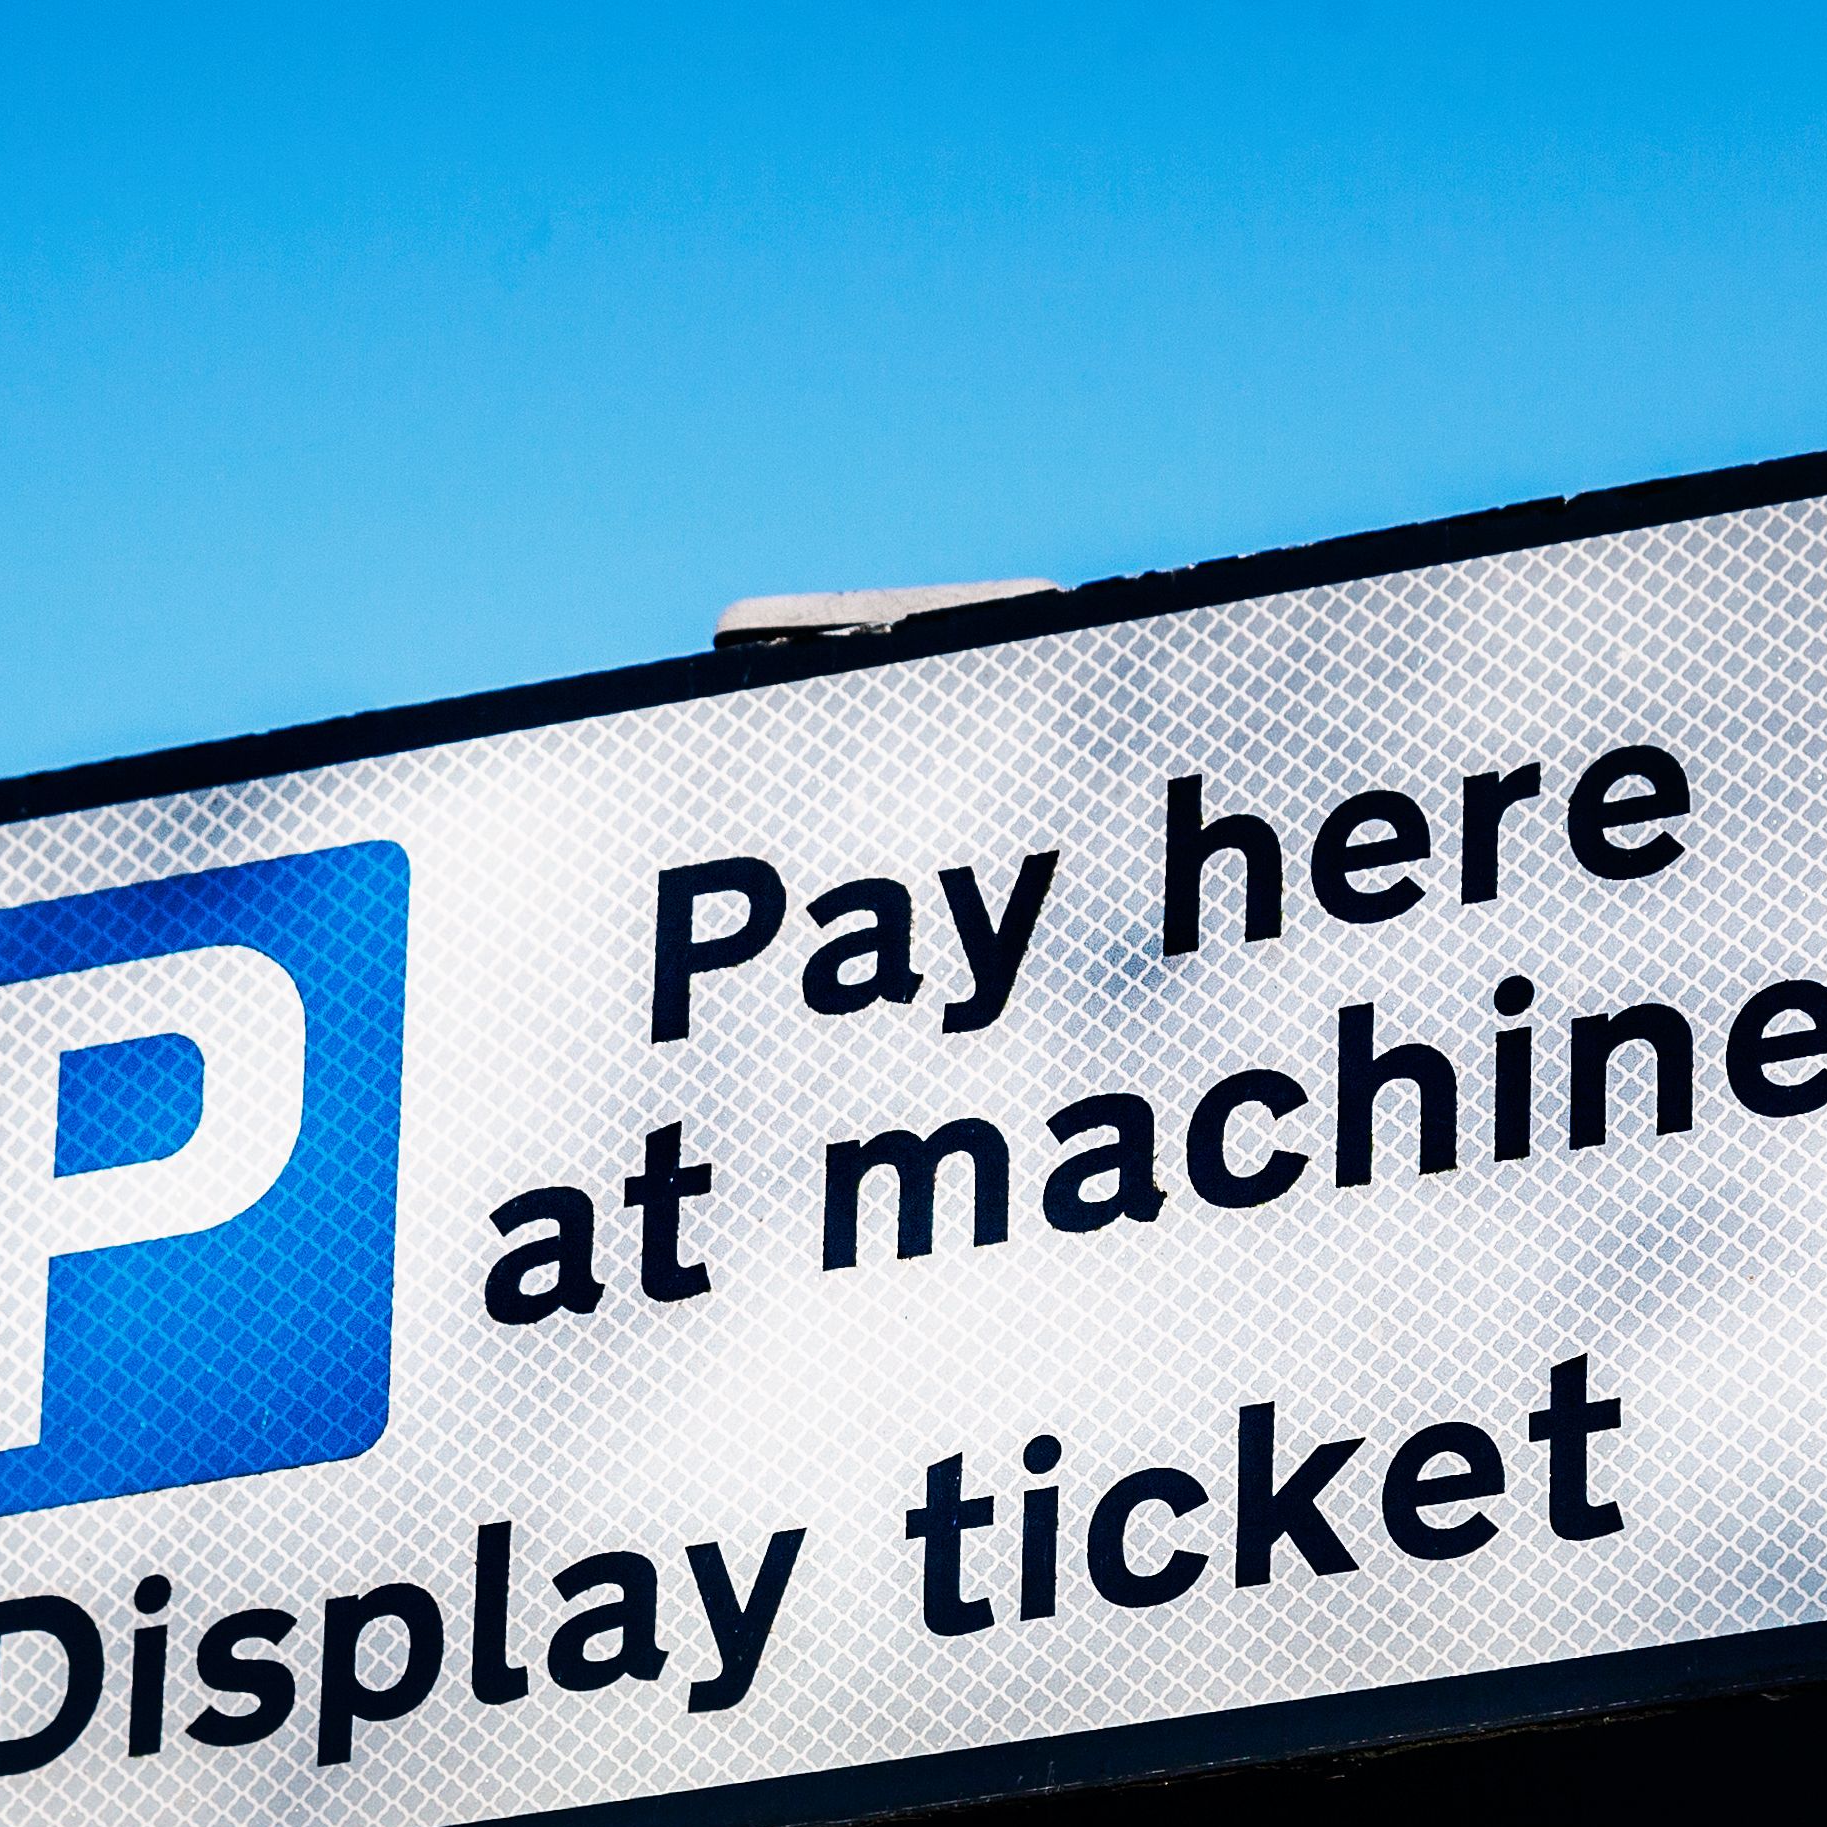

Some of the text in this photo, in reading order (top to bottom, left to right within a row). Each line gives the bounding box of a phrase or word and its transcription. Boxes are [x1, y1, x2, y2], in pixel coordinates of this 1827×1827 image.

[649, 743, 1692, 1046] Pay here
[483, 1119, 714, 1327] at
[904, 1351, 1626, 1638] ticket
